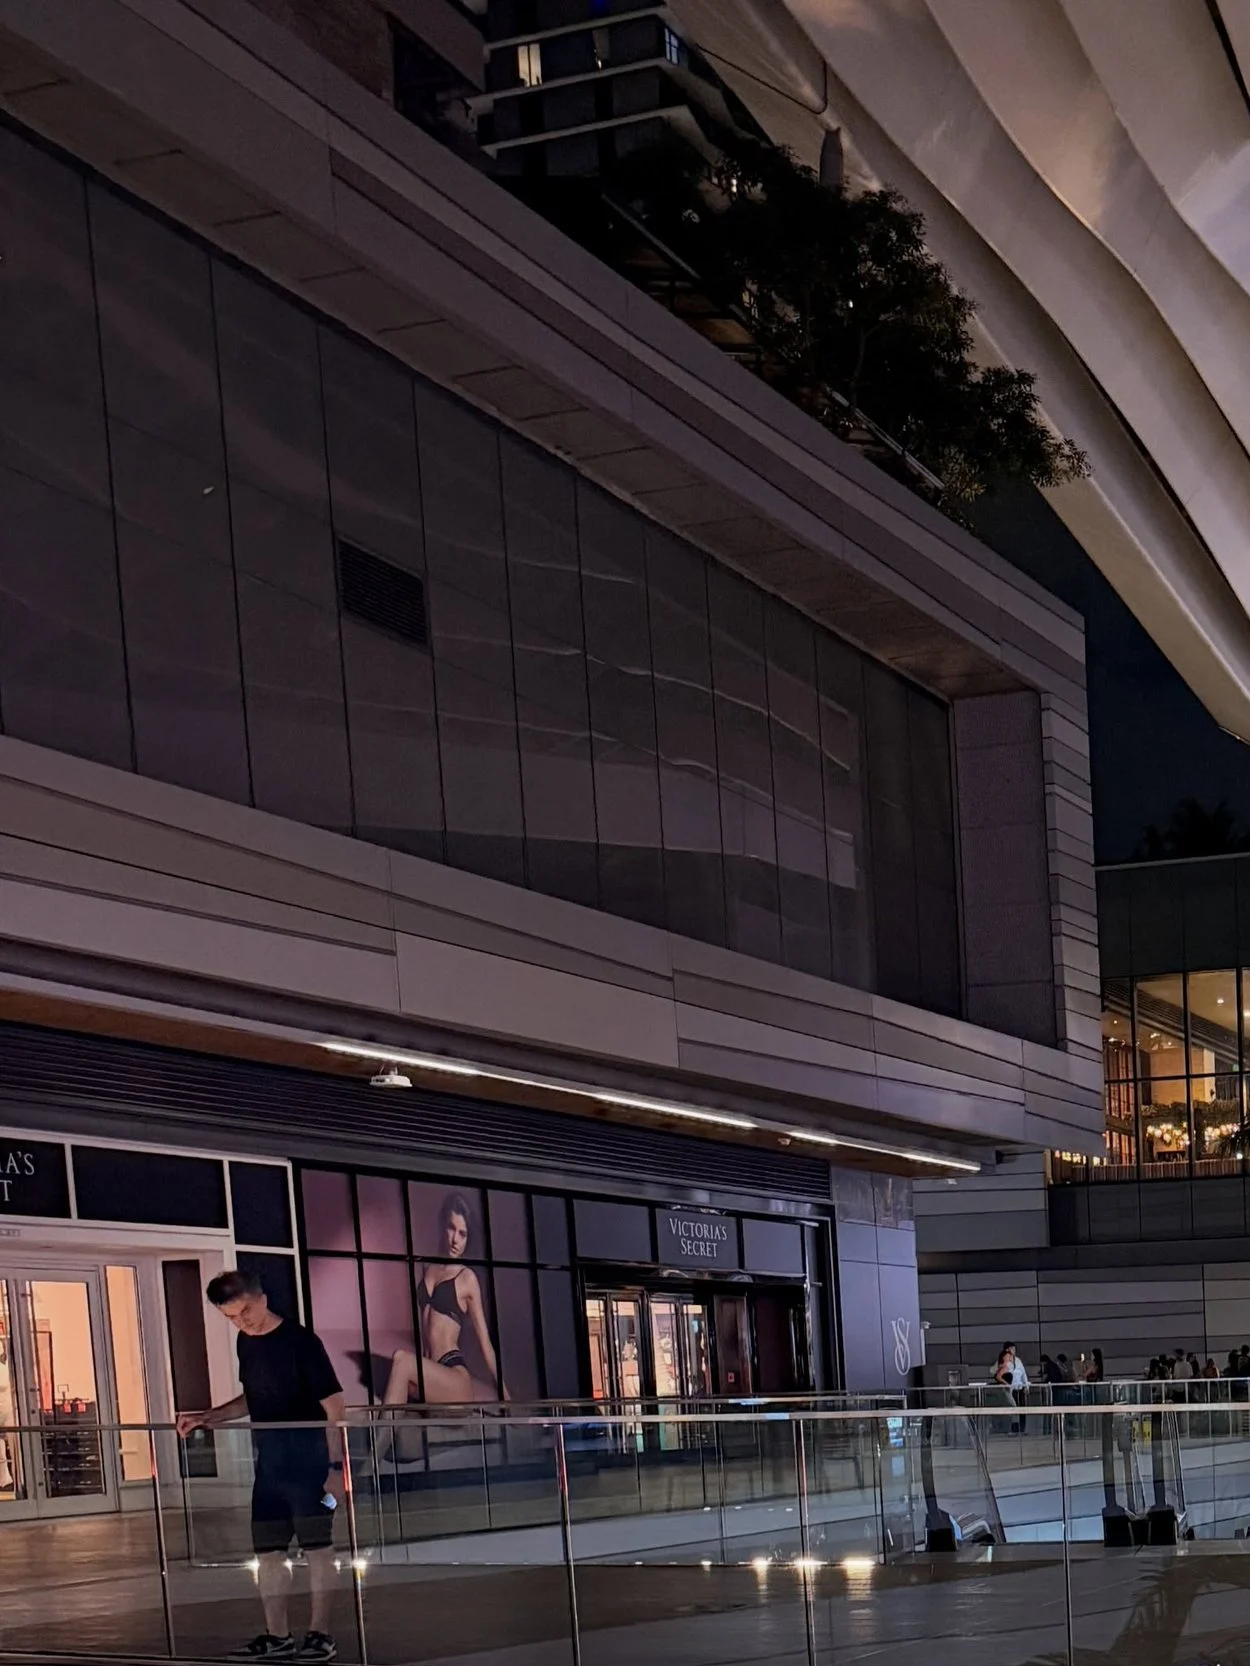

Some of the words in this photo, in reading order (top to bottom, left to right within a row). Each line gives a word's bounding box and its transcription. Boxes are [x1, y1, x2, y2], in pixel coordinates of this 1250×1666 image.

[0, 1151, 35, 1175] A'S
[669, 1217, 728, 1241] VICTORIA'S
[680, 1238, 718, 1258] SECRET
